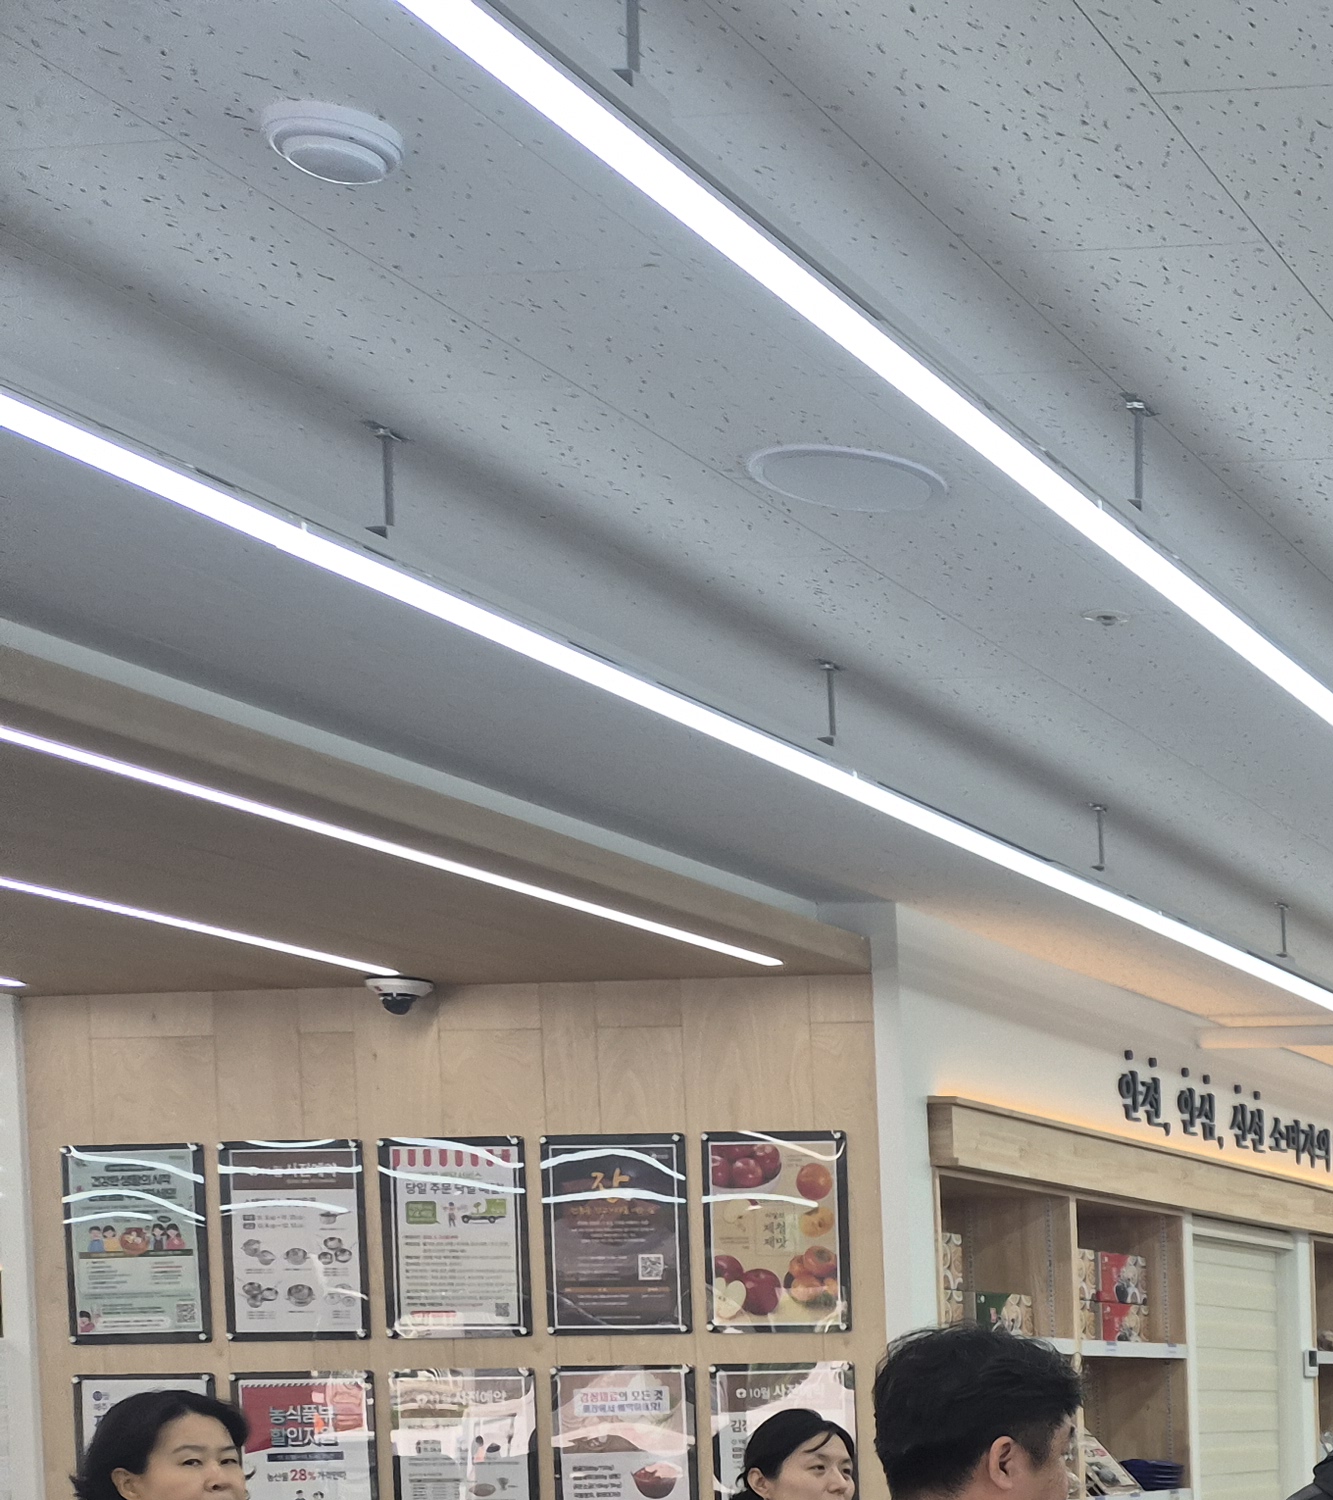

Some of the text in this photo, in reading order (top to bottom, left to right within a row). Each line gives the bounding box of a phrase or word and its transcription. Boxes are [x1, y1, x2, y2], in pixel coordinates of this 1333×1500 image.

[1118, 1070, 1171, 1137] 안전,
[1177, 1087, 1224, 1150] 안심,
[1230, 1103, 1266, 1154] 신선
[1269, 1116, 1332, 1173] 소비자의
[405, 1182, 427, 1195] 당일
[430, 1183, 452, 1195] 주문
[750, 1387, 771, 1399] 10월
[269, 1404, 336, 1424] 농식품부
[290, 1469, 317, 1481] 28%
